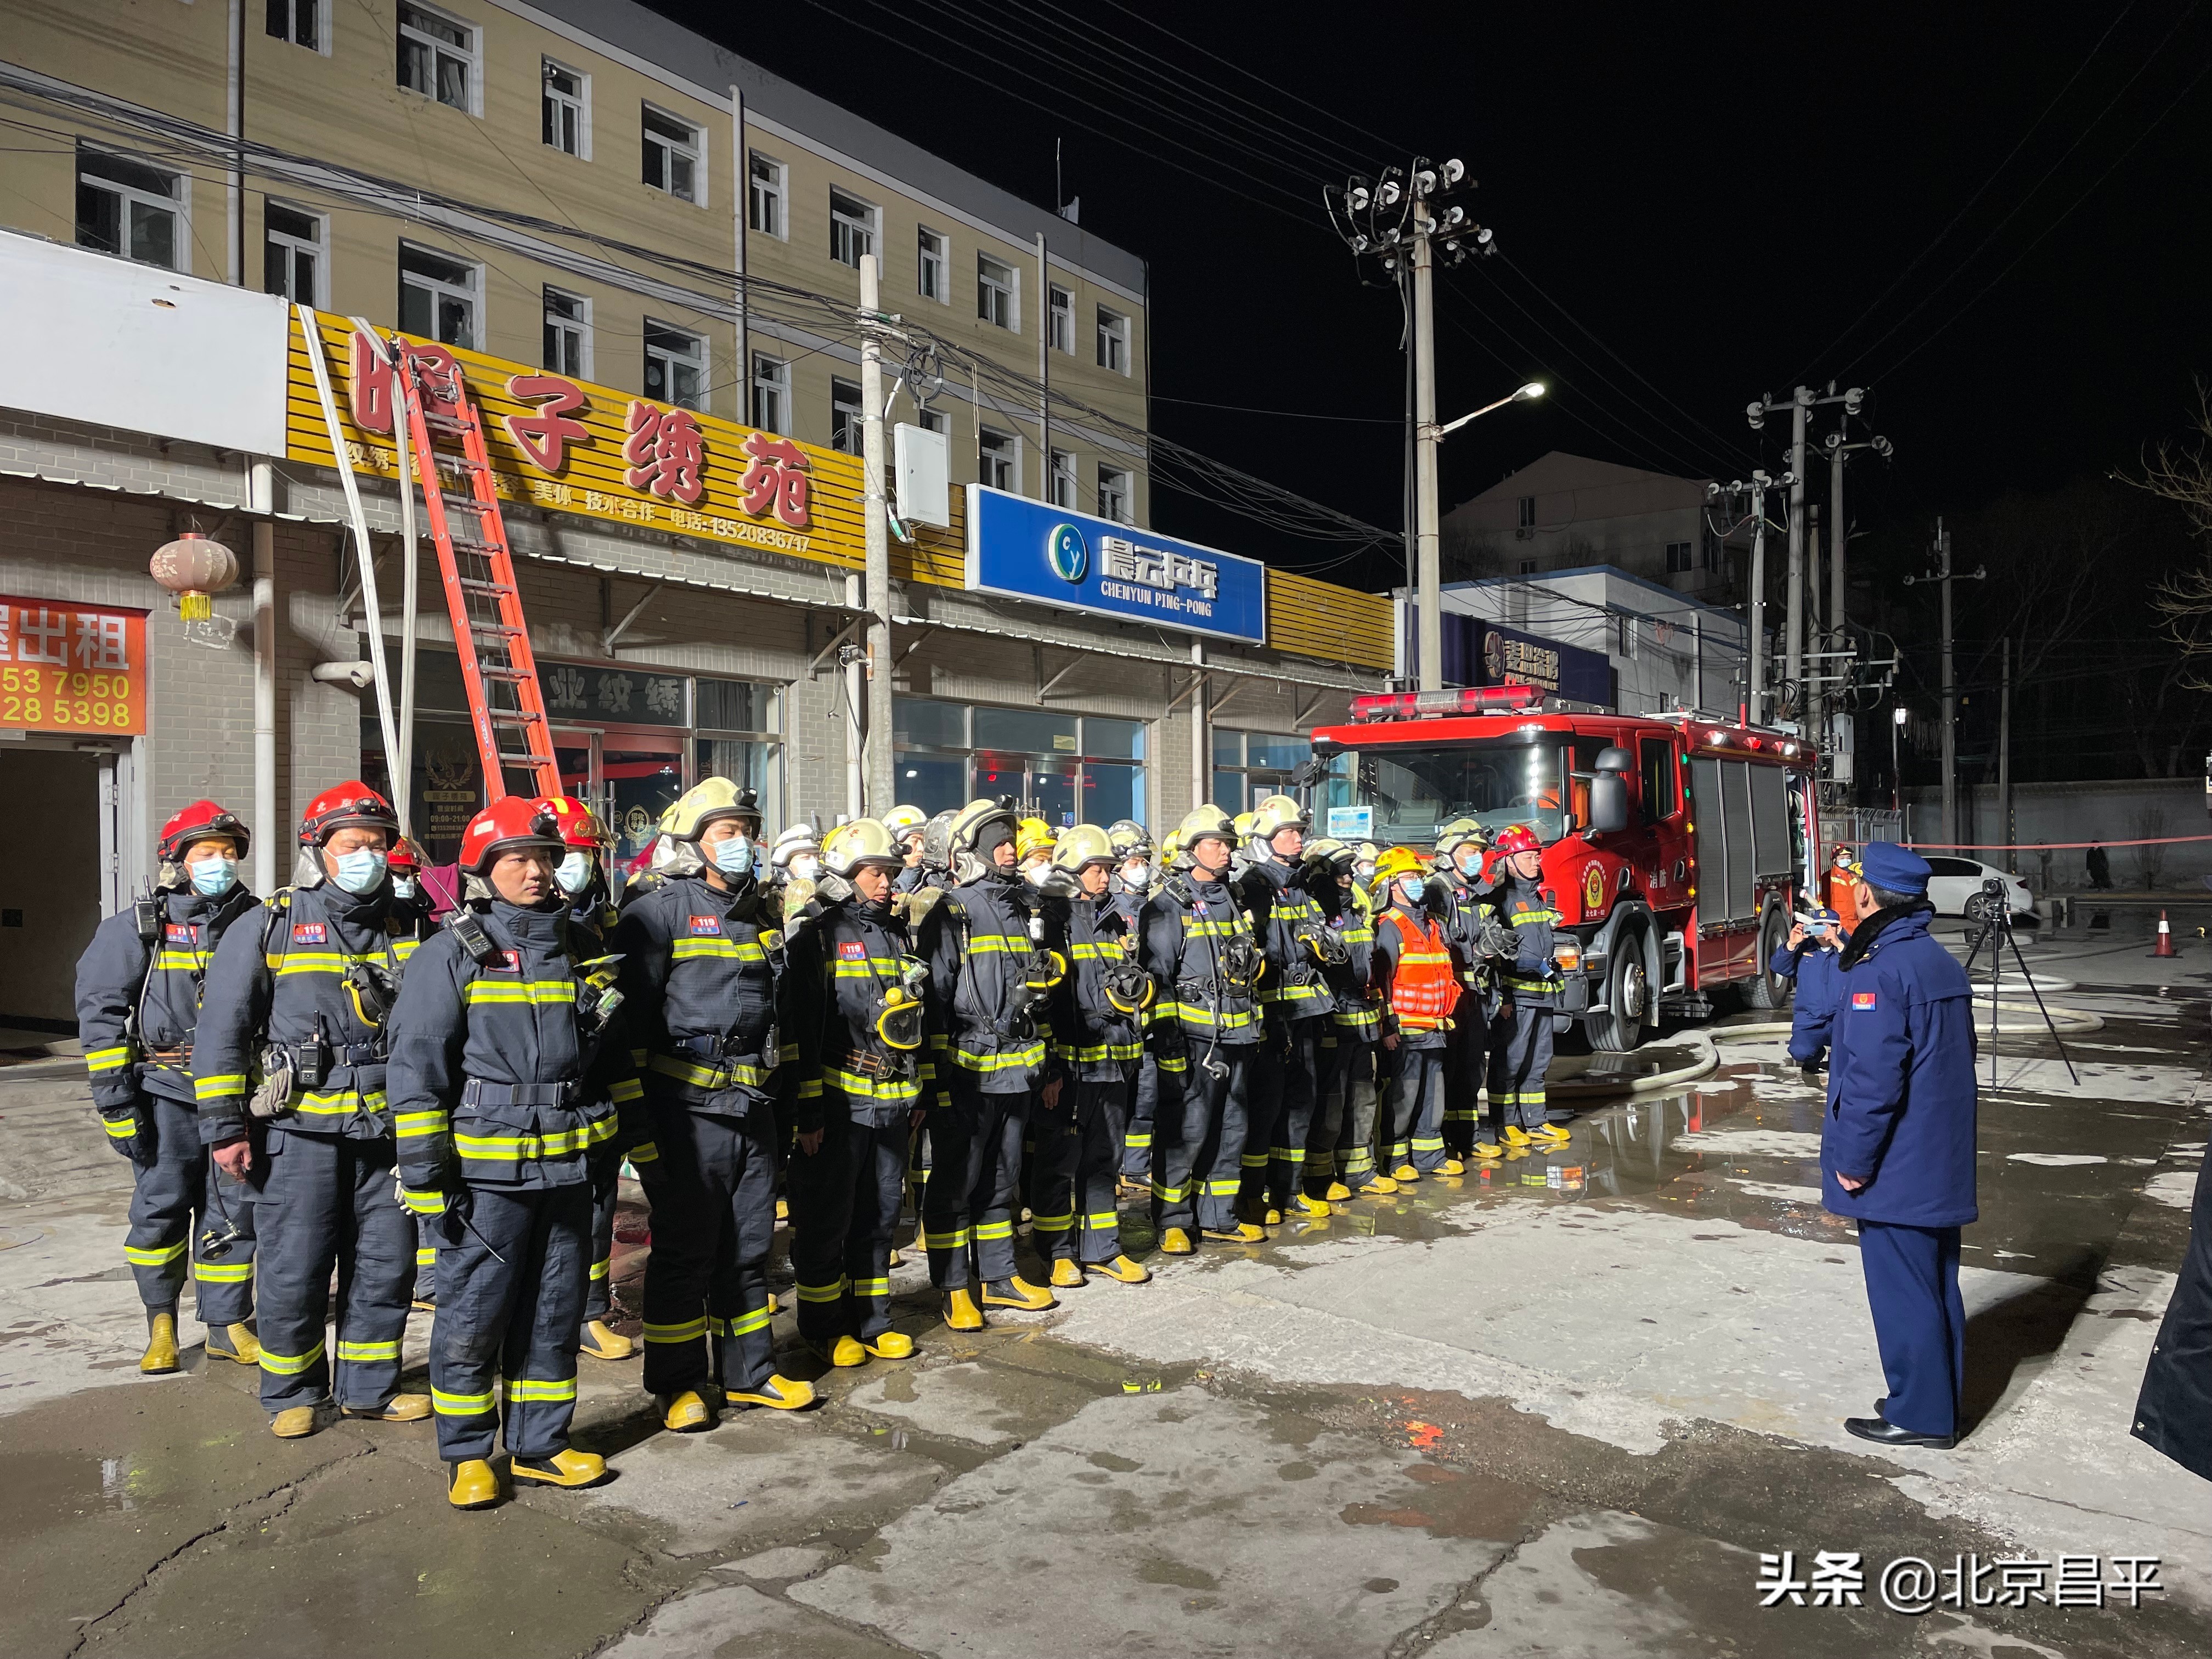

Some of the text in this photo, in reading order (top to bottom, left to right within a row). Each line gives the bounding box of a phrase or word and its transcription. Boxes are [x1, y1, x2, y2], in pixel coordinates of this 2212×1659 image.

[534, 480, 573, 506] 美体
[585, 490, 656, 522] 技术合作
[1102, 535, 1218, 601] 晨云乒乓
[1101, 582, 1212, 617] CHENYUN PING-PONG
[0, 605, 129, 670] 出租
[2, 668, 129, 699] 53 7950
[496, 668, 680, 718] 业纹绣
[3, 696, 130, 727] 28 5398
[1649, 868, 1667, 889] 消防
[303, 925, 322, 934] 119
[697, 918, 715, 926] 119
[845, 944, 861, 953] 119
